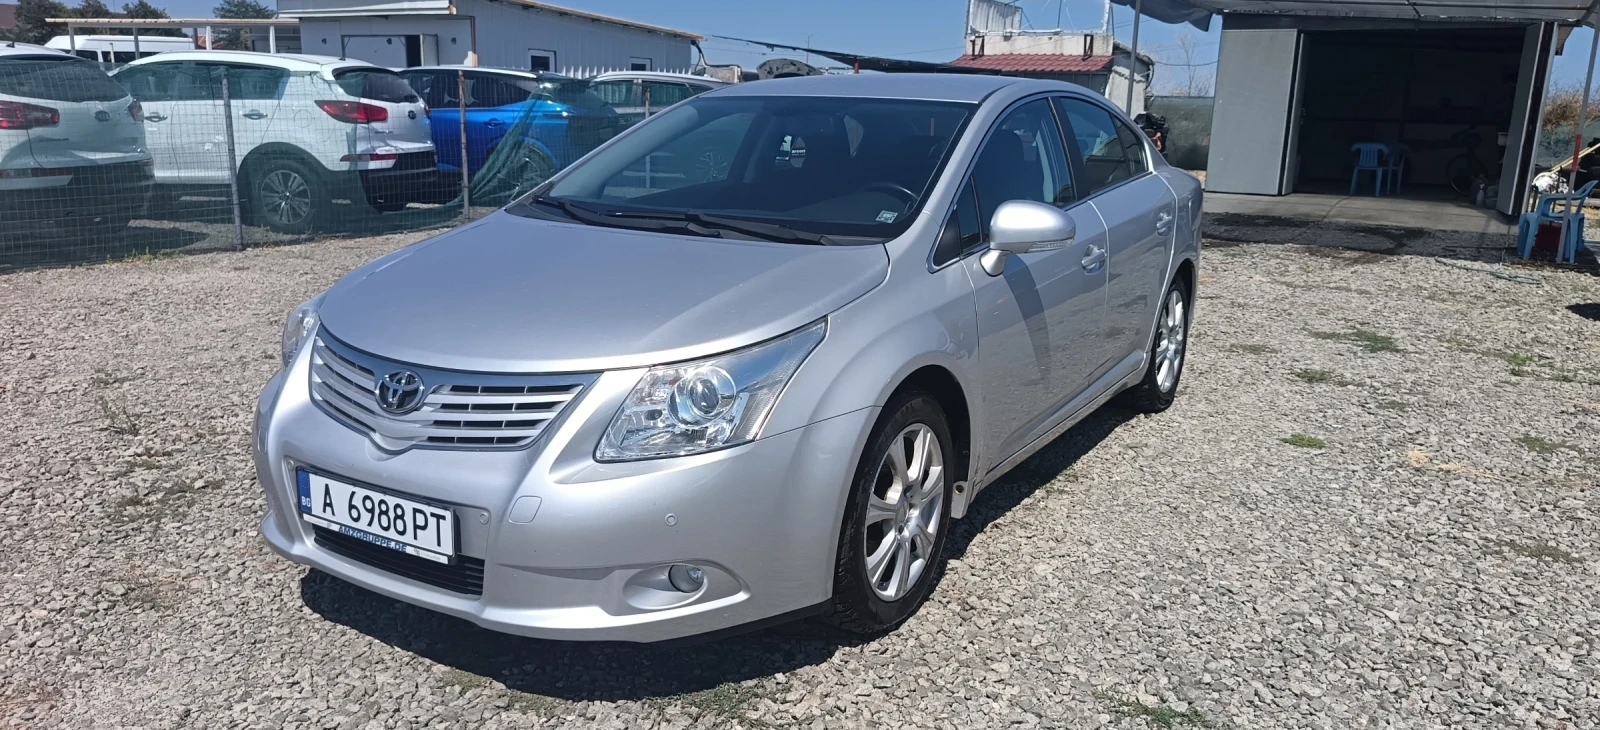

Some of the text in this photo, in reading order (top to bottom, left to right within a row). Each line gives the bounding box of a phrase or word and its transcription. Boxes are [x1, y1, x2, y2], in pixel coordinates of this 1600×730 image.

[301, 496, 311, 508] BG
[322, 483, 336, 517] A
[338, 526, 407, 552] AMZGRUPPE.DE
